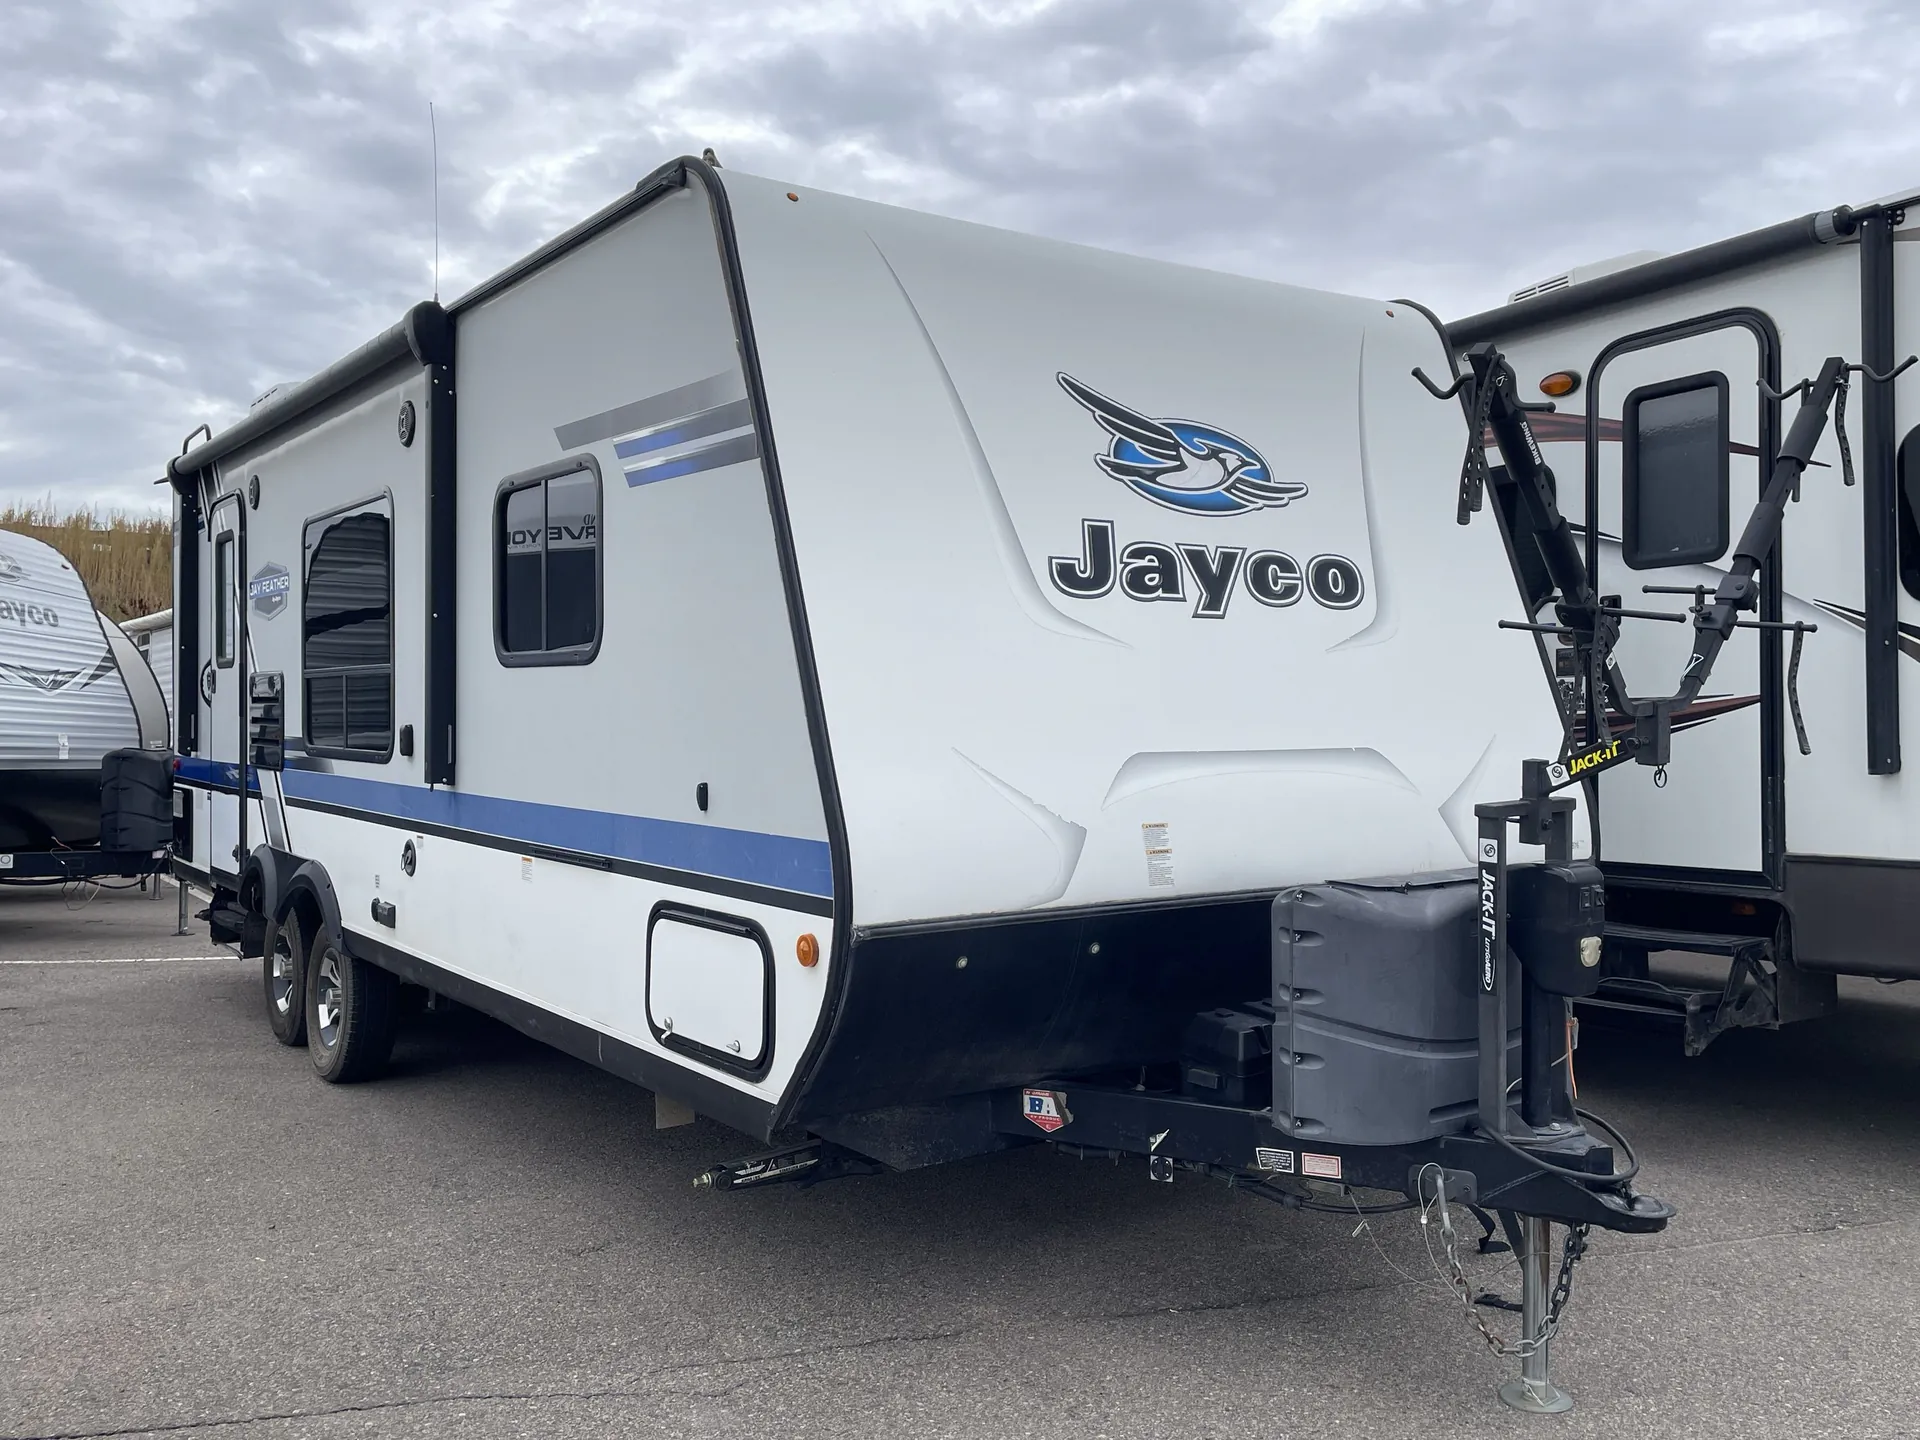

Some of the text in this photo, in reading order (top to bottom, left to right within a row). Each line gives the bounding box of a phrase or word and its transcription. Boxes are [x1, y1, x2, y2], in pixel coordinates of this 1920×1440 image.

[250, 576, 289, 596] JAY FEATHER
[1048, 518, 1365, 619] Jayco
[0, 600, 59, 628] ayco
[1570, 740, 1619, 775] JACK-IT
[1482, 869, 1496, 938] JACK-IT
